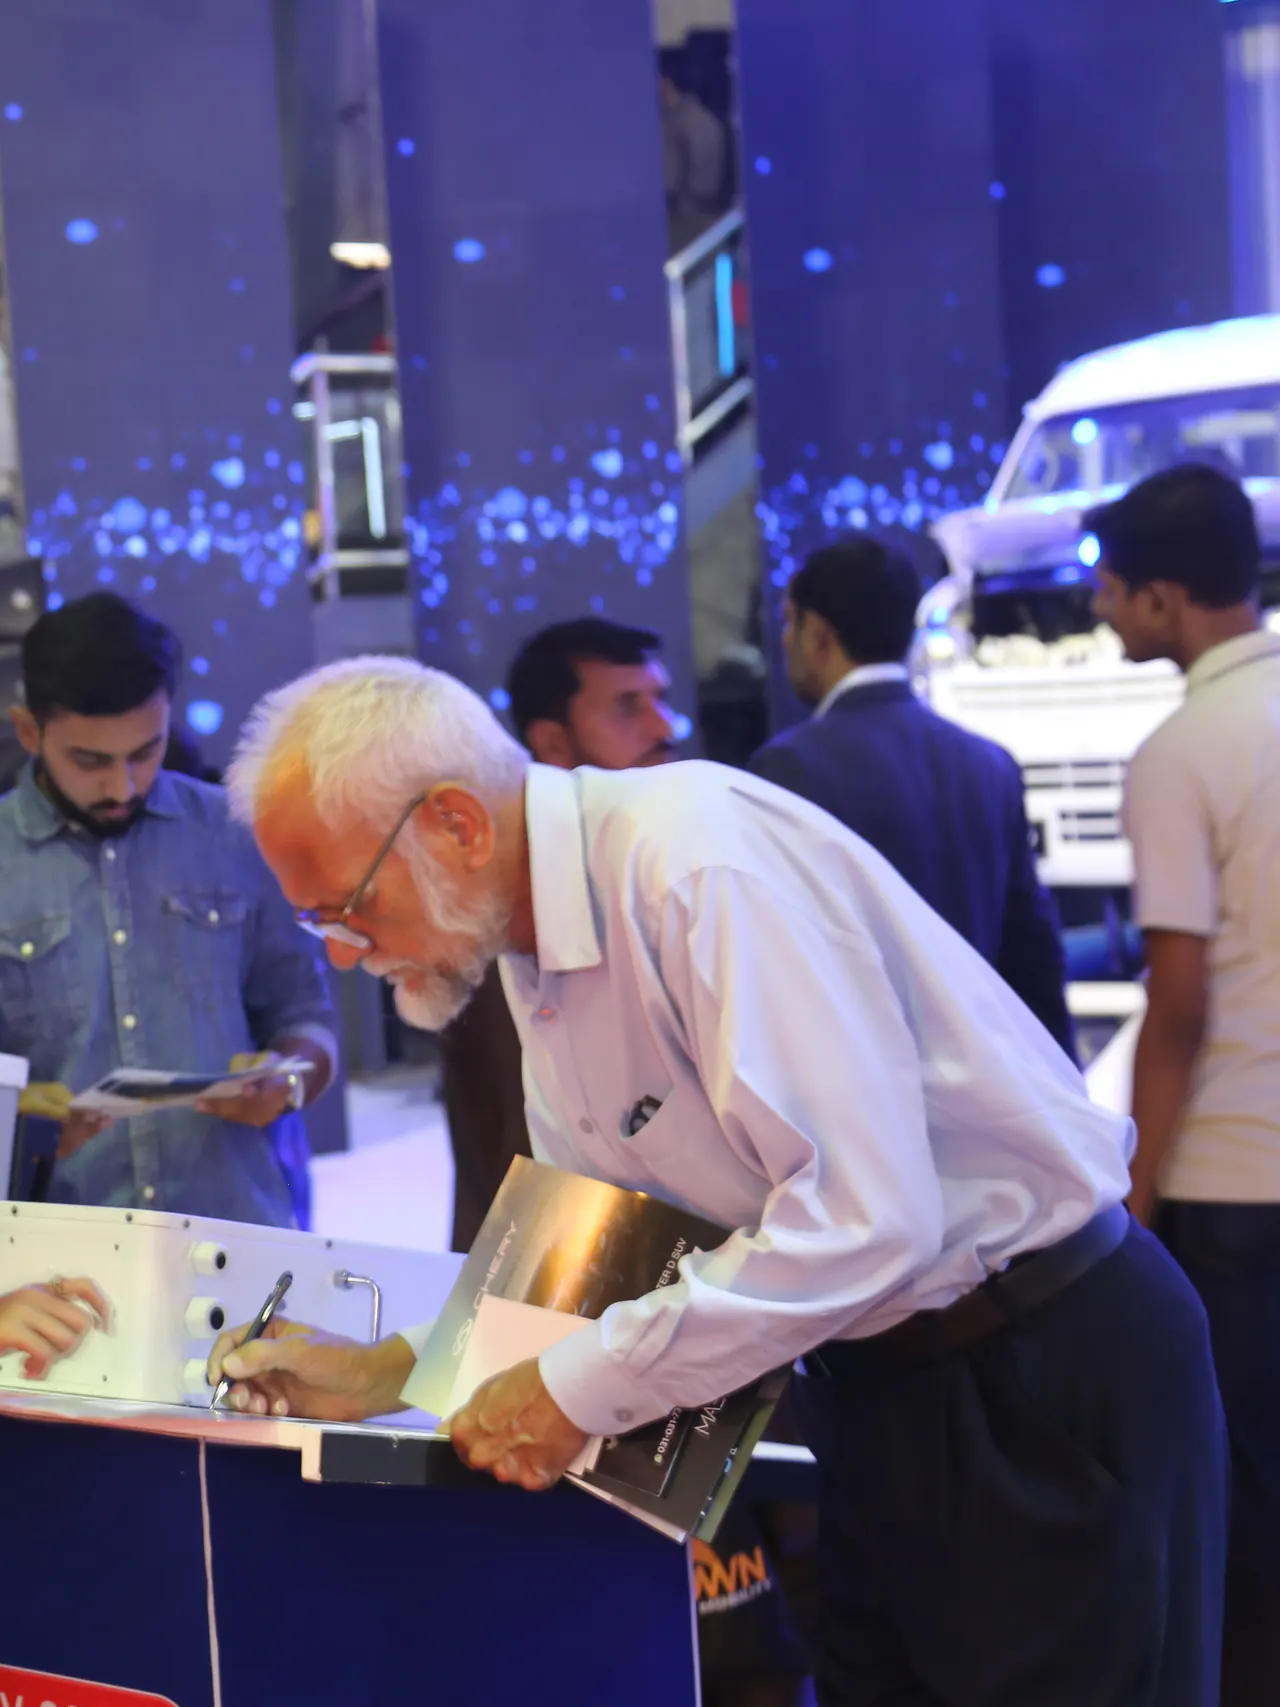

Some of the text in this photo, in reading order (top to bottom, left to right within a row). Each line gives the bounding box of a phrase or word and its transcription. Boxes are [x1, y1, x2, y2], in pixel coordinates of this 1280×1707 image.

[655, 1237, 687, 1290] TER D SUV
[694, 1397, 727, 1436] MA
